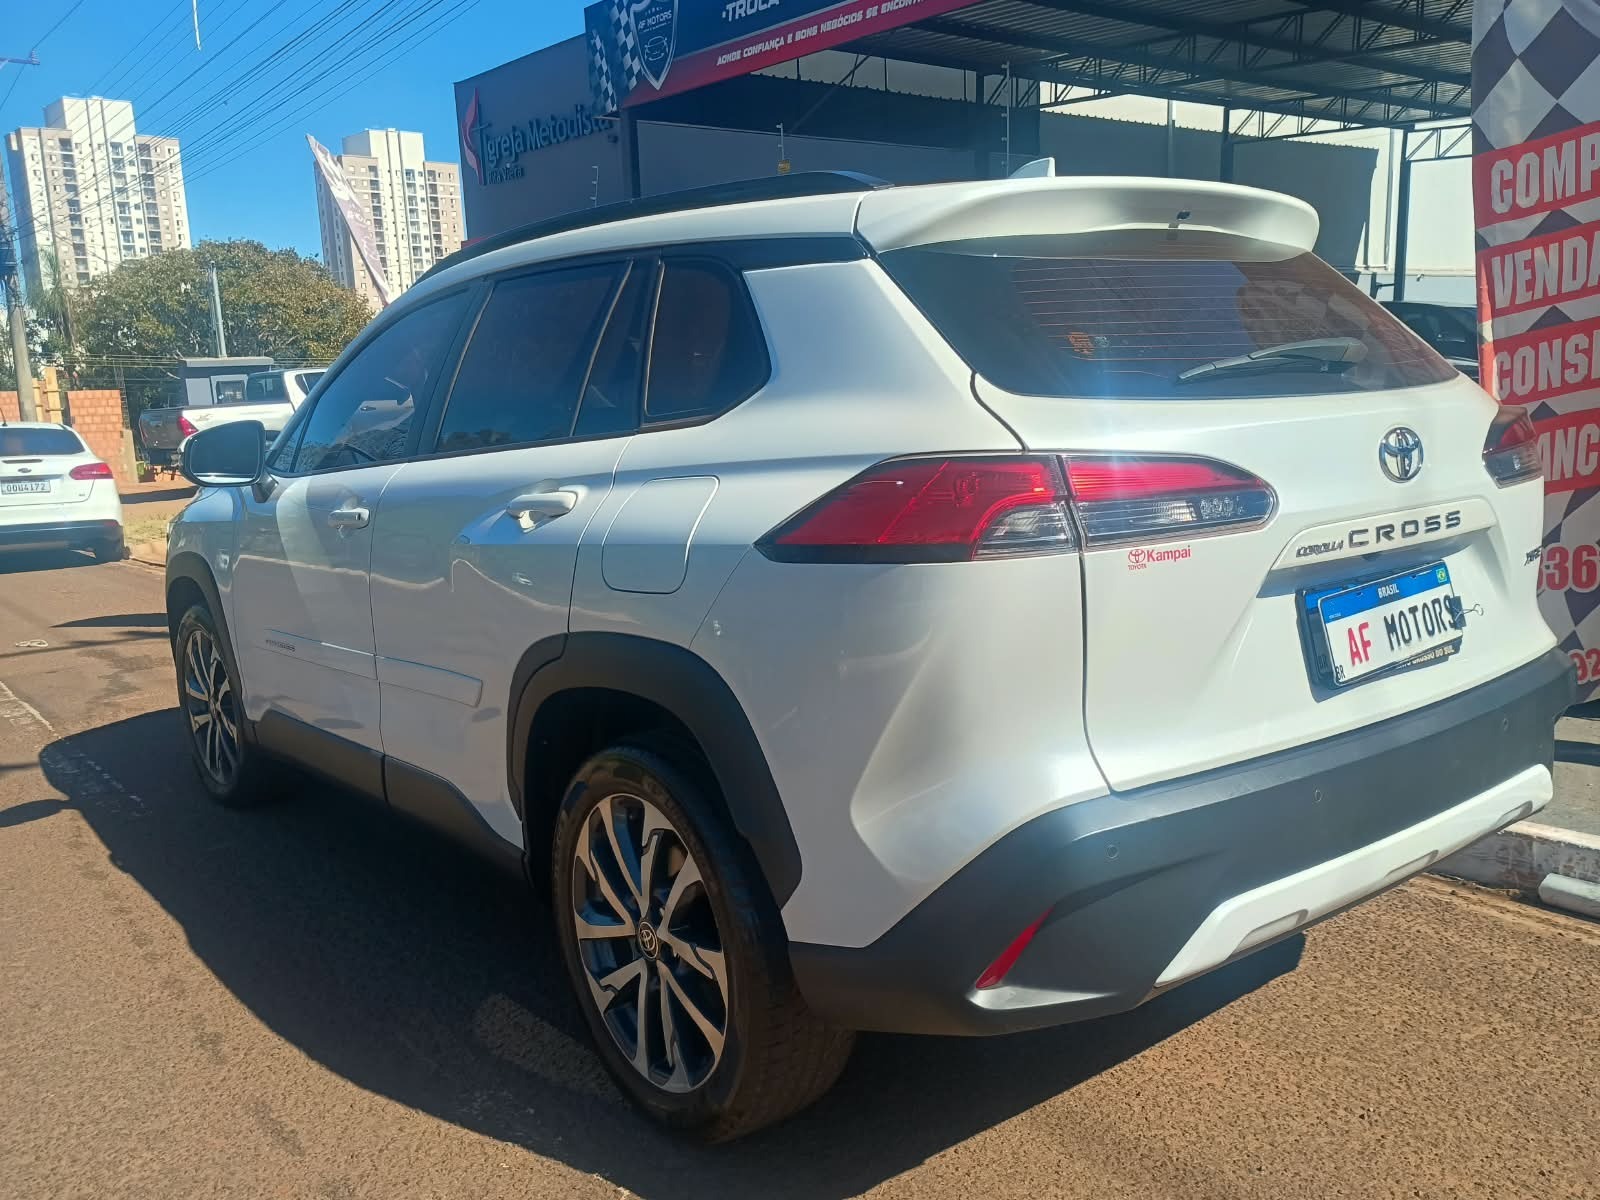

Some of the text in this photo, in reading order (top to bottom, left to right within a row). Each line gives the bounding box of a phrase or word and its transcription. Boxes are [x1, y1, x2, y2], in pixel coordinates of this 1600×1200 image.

[647, 10, 672, 26] MOTORS
[716, 50, 741, 66] AONDE
[743, 36, 785, 58] CONFIANÇA
[787, 33, 793, 44] E
[795, 25, 818, 42] BONS
[866, 7, 878, 19] SE
[880, 0, 923, 14] ENCON
[483, 130, 524, 166] Igreja
[1296, 510, 1461, 558] COROLLA CROSS
[1147, 545, 1191, 562] Kampai
[1377, 583, 1400, 599] BRASIL
[1347, 594, 1456, 667] AF MOTORS
[1335, 664, 1346, 681] BR
